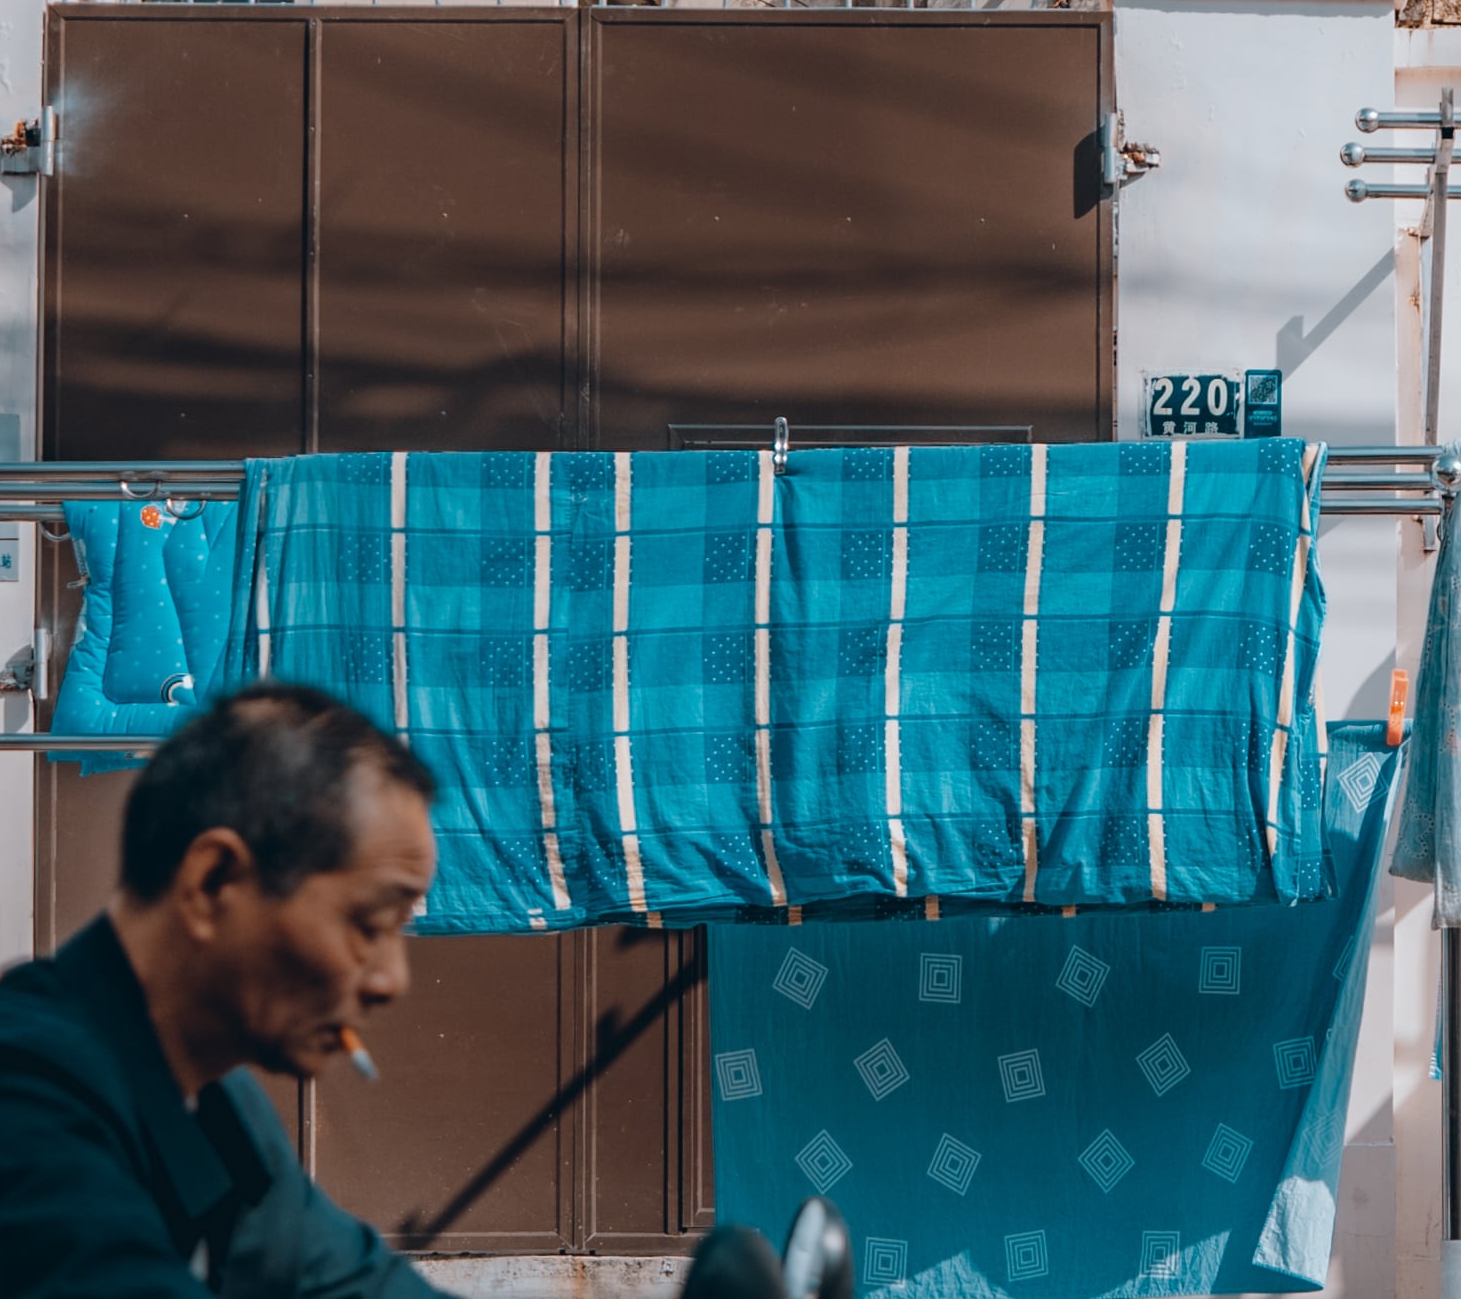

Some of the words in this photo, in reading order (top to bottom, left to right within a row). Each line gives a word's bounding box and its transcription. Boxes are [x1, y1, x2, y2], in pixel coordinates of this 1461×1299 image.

[1153, 377, 1228, 416] 220
[1162, 420, 1219, 435] 黄河路
